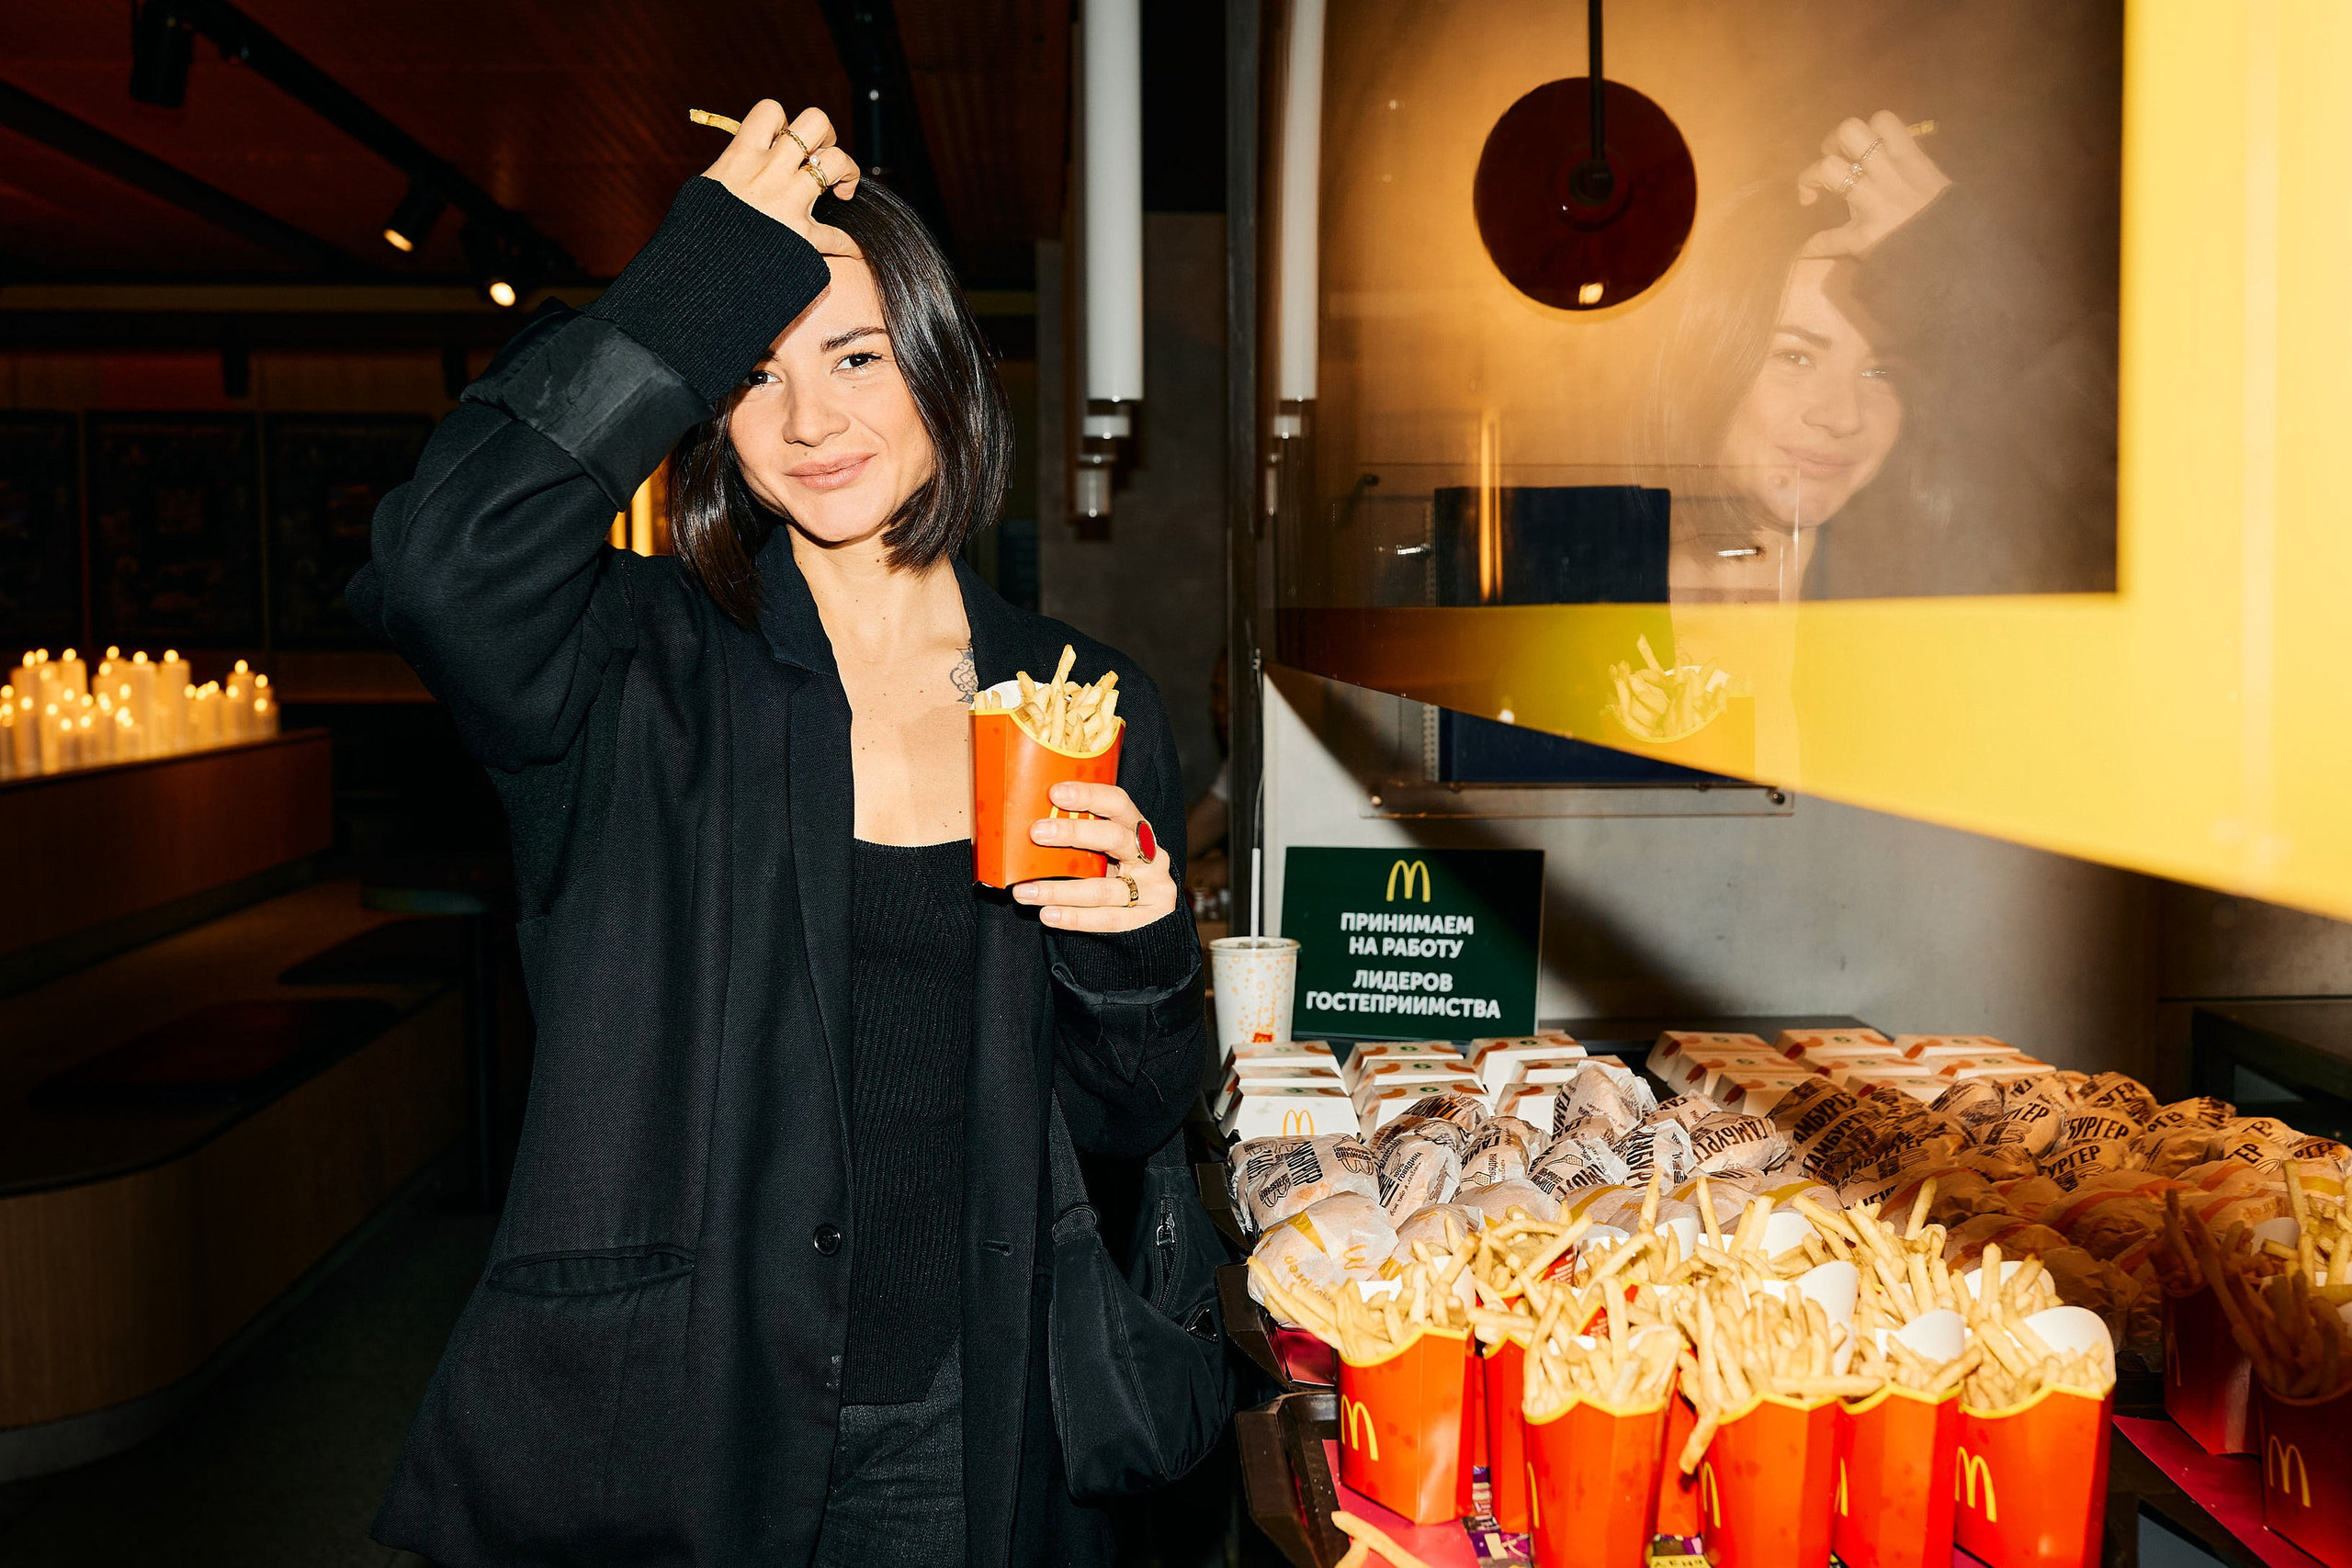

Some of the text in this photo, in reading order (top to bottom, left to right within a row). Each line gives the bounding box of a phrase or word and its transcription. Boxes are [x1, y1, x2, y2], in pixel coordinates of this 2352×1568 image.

[1340, 912, 1475, 936] ПРИНИМАЕМ
[1349, 935, 1464, 959] НА РАБОТУ
[1352, 969, 1453, 993] ЛИДЕРОВ
[1306, 990, 1501, 1020] ГОСТЕПРИИМСТВА
[2066, 1116, 2130, 1140] БУРГЕР
